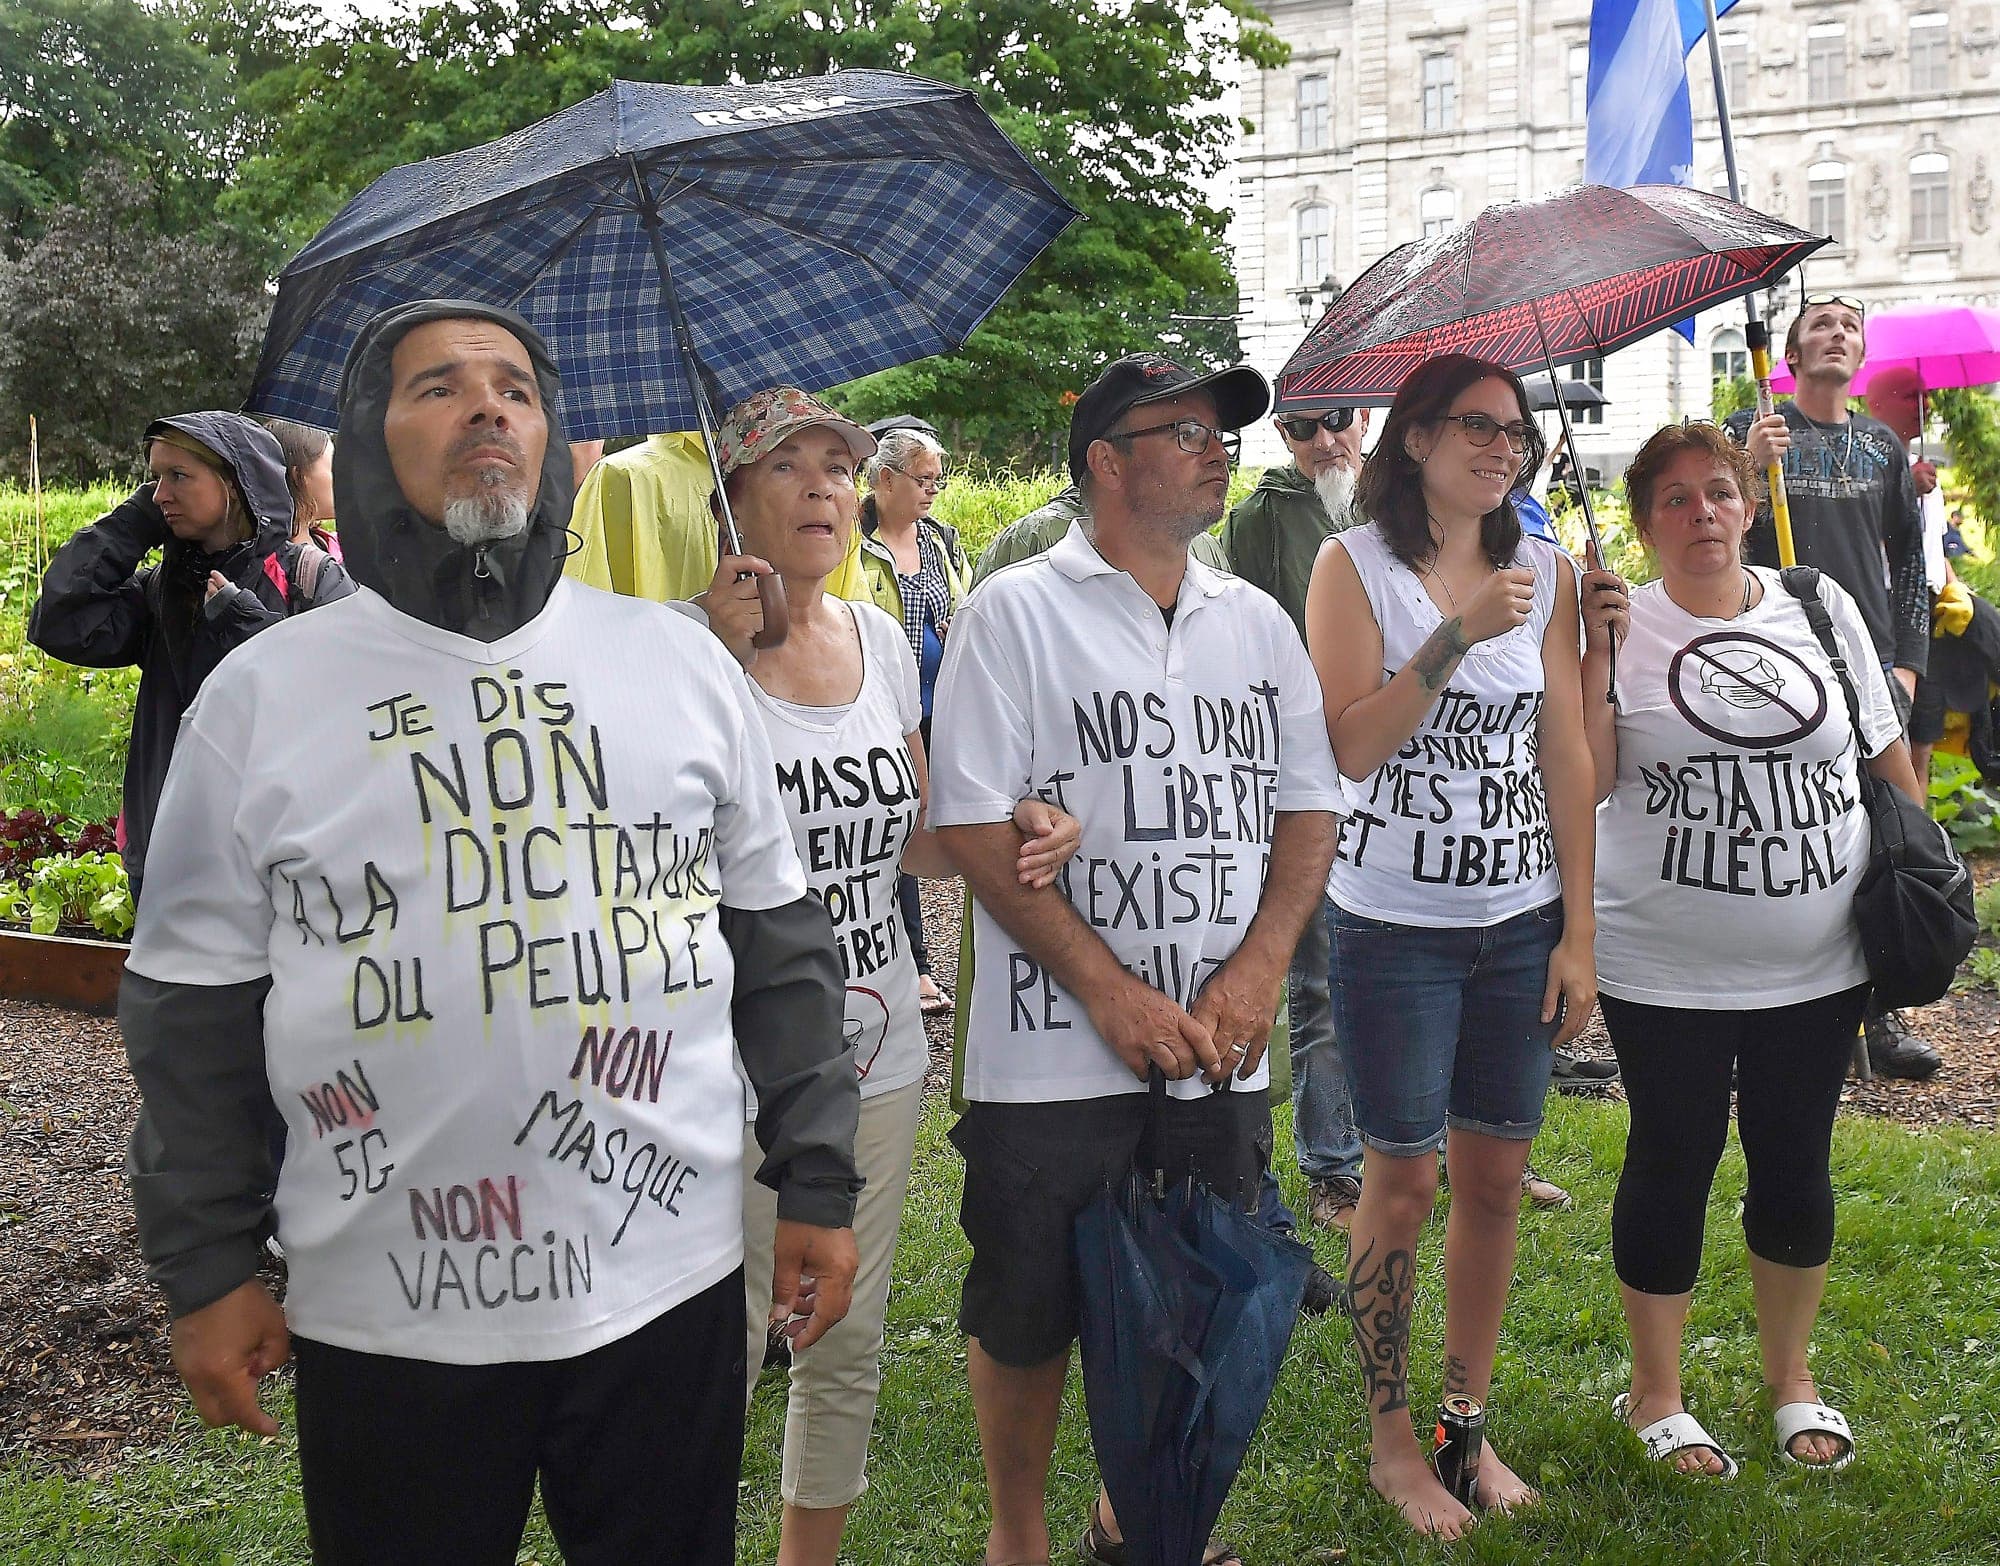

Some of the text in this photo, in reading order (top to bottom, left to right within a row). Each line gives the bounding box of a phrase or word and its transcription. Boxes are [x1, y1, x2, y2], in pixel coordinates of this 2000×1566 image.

[366, 693, 433, 741] JE
[1072, 690, 1175, 766] NOS
[411, 725, 608, 823] NON
[1369, 762, 1453, 824] MES
[1337, 809, 1387, 868] ET
[319, 861, 399, 944] LA
[352, 906, 713, 1030] DU PEUPLE
[298, 1060, 381, 1138] NON
[568, 1026, 673, 1103] NON
[333, 1128, 395, 1201] 5G
[408, 1175, 522, 1243] NON
